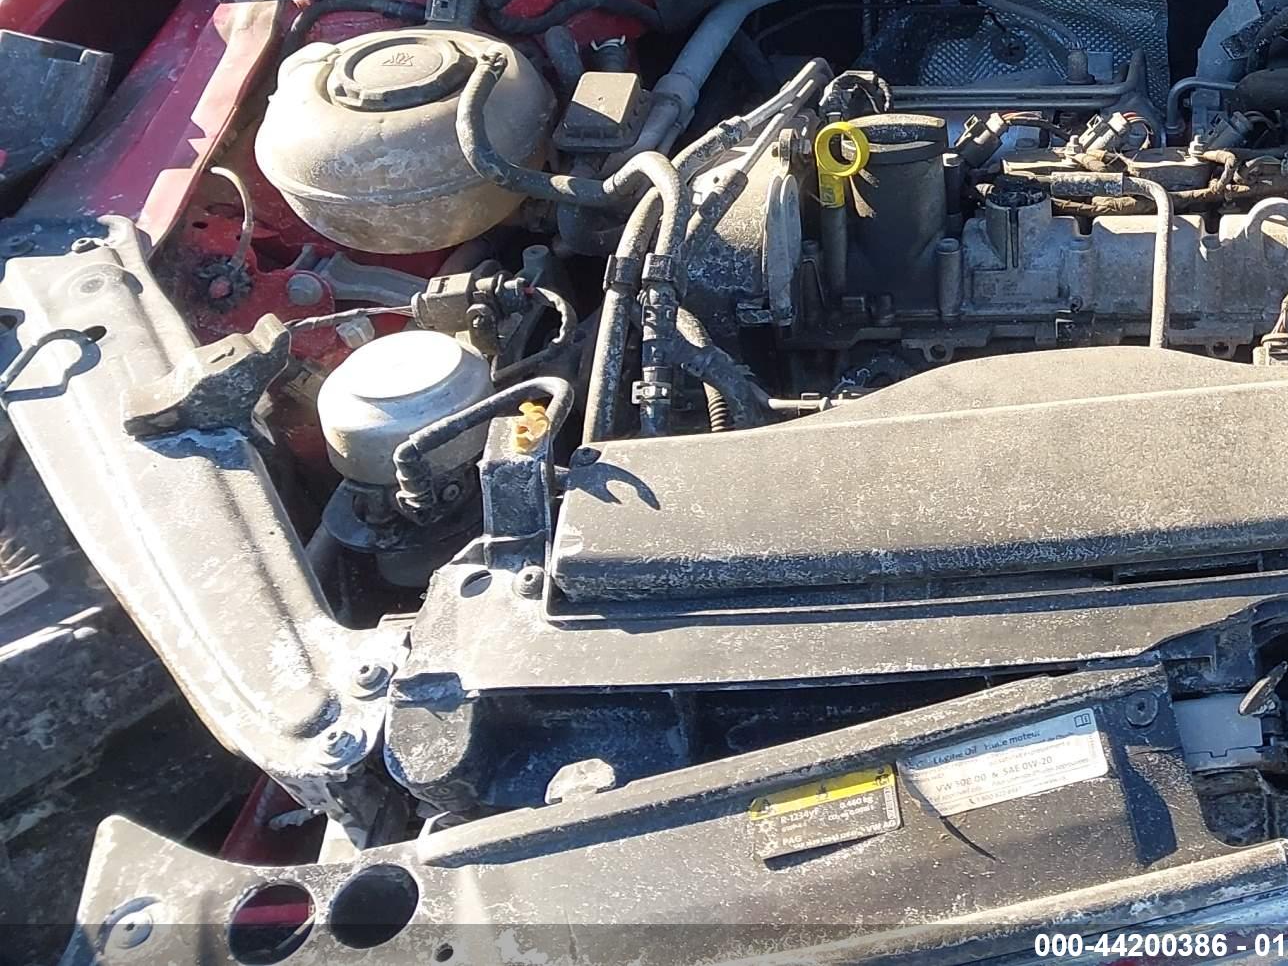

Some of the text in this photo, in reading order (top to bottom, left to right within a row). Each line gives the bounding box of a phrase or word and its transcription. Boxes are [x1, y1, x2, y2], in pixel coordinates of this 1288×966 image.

[964, 745, 977, 755] Oil
[1002, 766, 1020, 776] SAE
[782, 835, 803, 846] PAG
